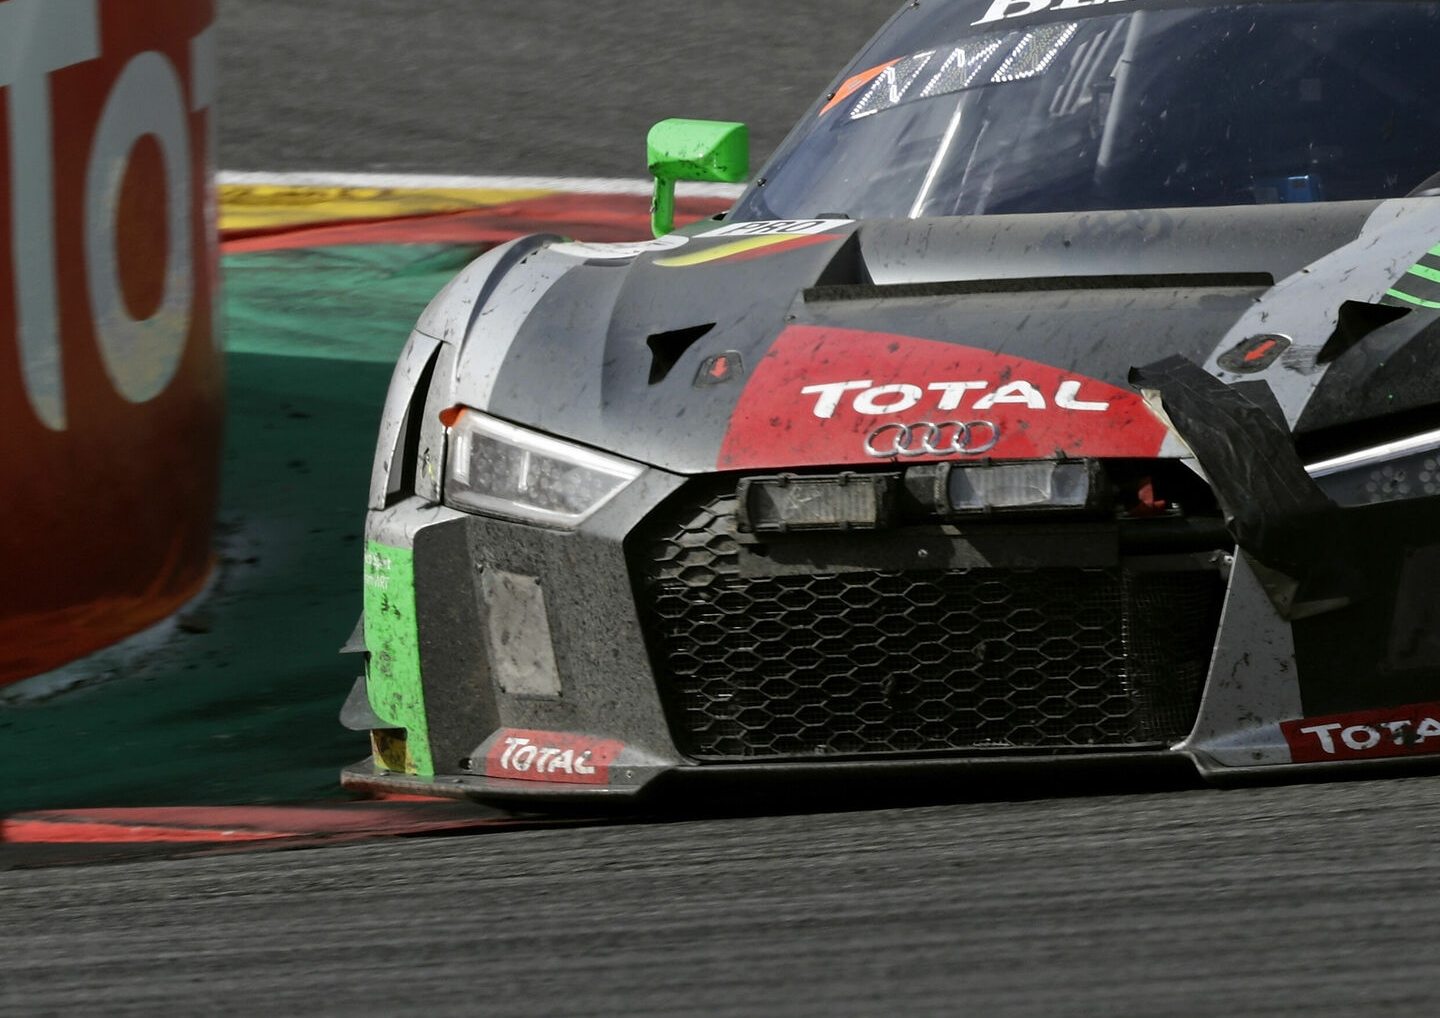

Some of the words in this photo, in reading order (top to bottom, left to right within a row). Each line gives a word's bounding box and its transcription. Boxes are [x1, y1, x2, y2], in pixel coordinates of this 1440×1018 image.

[720, 220, 826, 235] PRO
[801, 379, 1111, 419] TOTAL
[501, 737, 596, 775] TOTAL
